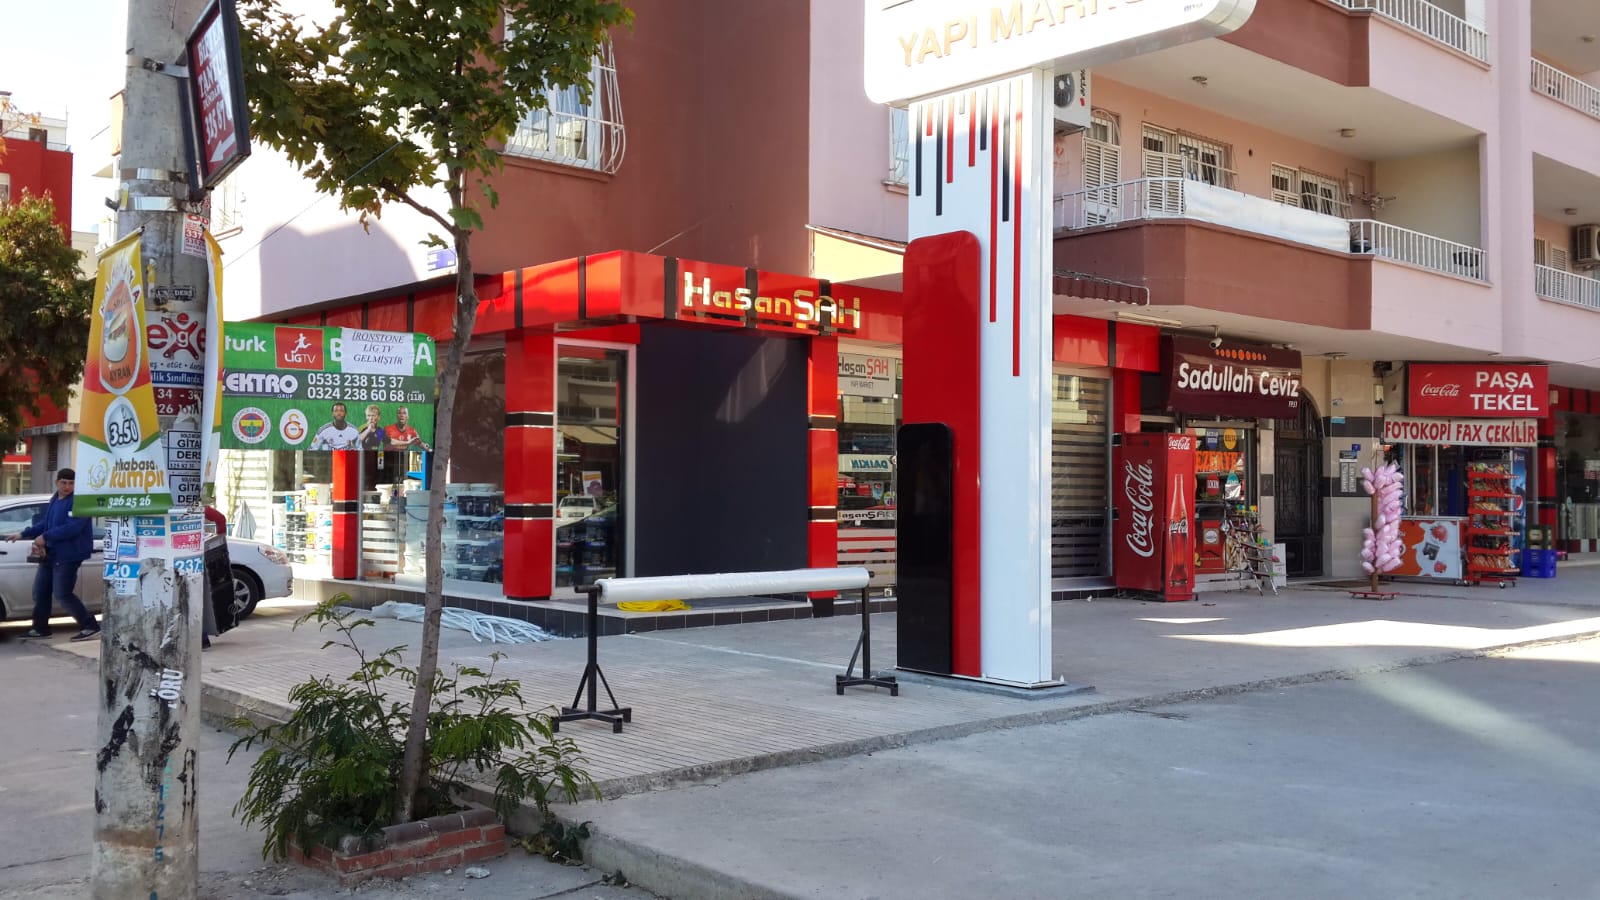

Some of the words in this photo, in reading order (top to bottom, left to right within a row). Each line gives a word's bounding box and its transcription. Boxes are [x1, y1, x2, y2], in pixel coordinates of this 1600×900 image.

[898, 15, 978, 67] YAPI
[308, 373, 341, 386] 0533
[344, 375, 368, 387] 238
[371, 376, 386, 388] 15
[389, 377, 404, 388] 37
[1178, 363, 1254, 393] Sadullah
[1259, 371, 1299, 397] Ceviz
[1475, 371, 1534, 393] PAŞA
[307, 387, 341, 400] 0324
[344, 389, 368, 401] 238
[371, 390, 387, 401] 60
[390, 391, 405, 402] 68
[1470, 394, 1540, 411] TEKEL
[109, 418, 139, 447] 3.50
[1385, 419, 1451, 440] FOTOKOPİ
[1456, 423, 1483, 442] FAX
[1485, 421, 1537, 444] ÇEKİLİR
[177, 438, 201, 448] GİTA
[108, 494, 125, 508] 326
[125, 495, 137, 506] 25
[139, 494, 151, 506] 26
